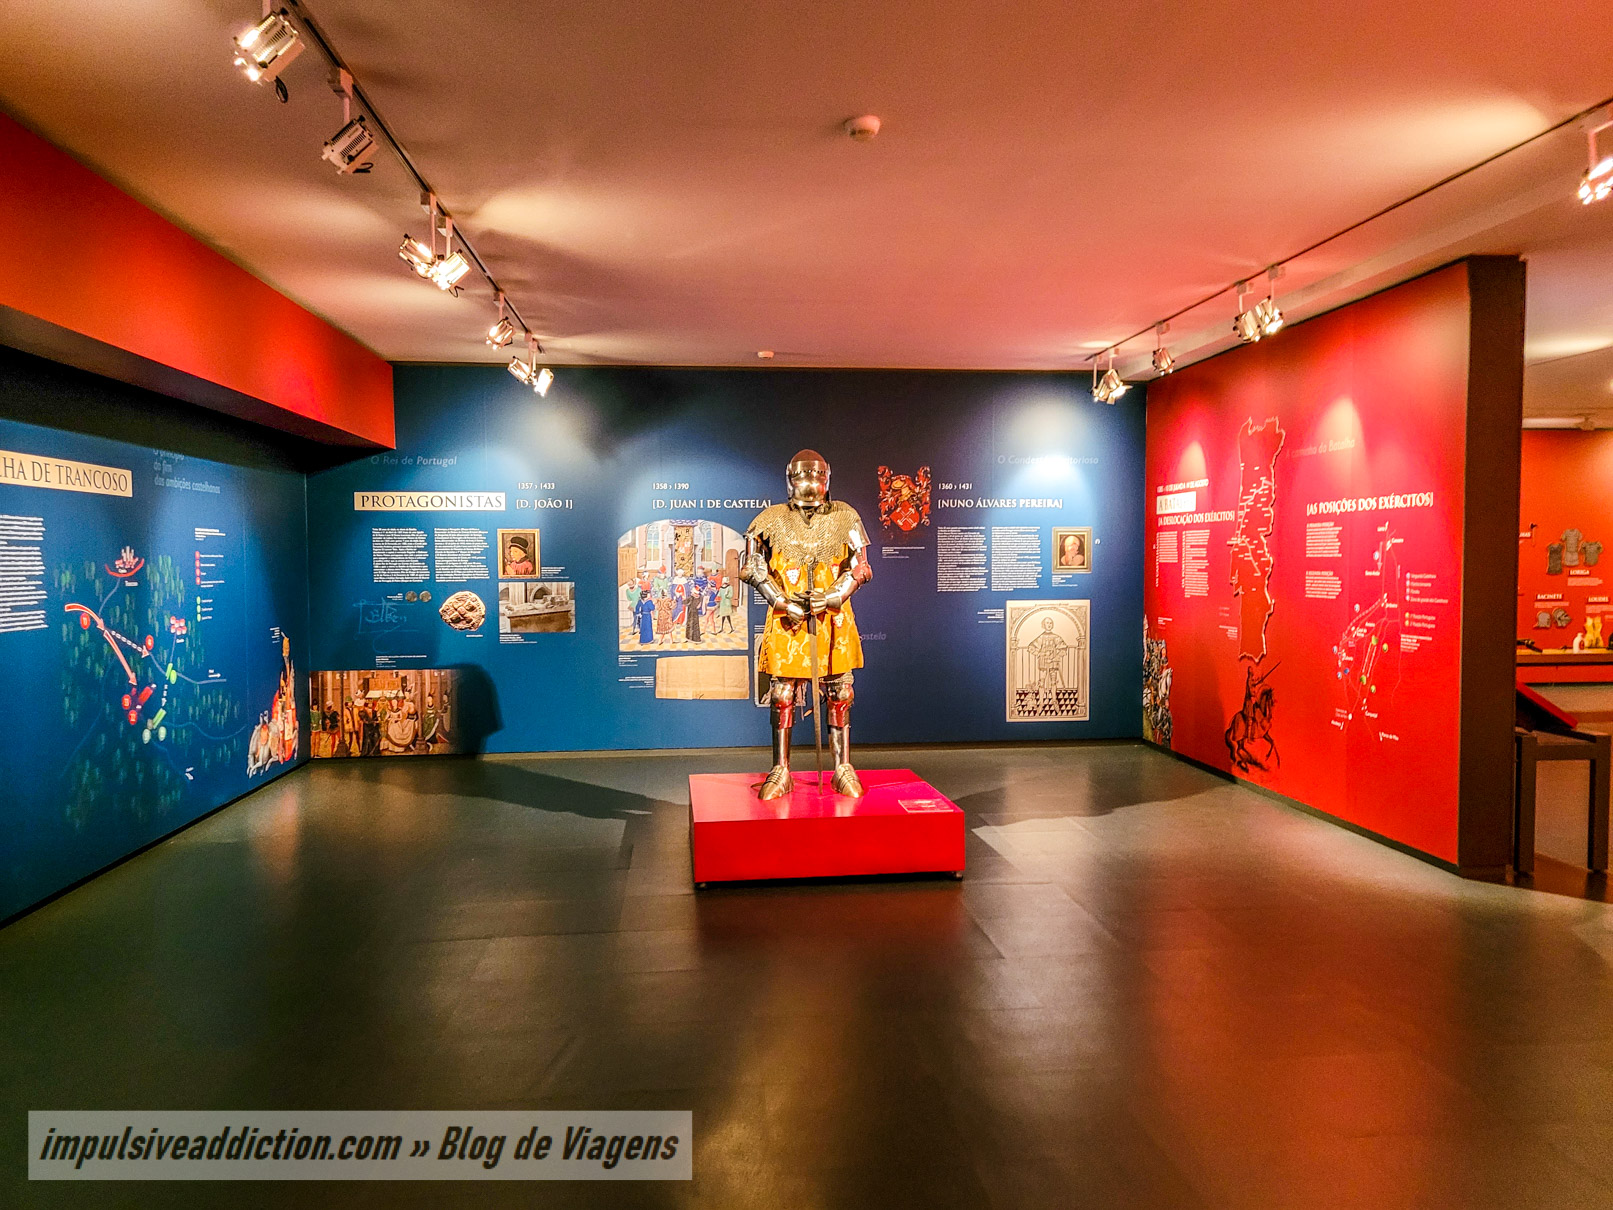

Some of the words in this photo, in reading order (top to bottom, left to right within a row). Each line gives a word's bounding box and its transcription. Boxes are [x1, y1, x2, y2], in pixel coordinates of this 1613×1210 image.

[370, 455, 380, 465] O
[383, 455, 399, 465] Rei
[401, 456, 413, 465] de
[416, 455, 458, 468] Portugal
[997, 455, 1006, 464] O
[0, 456, 27, 480] HA
[31, 461, 51, 483] DE
[55, 464, 128, 492] TRANCOSO
[517, 482, 533, 490] 1357
[540, 482, 555, 490] 1433
[360, 494, 502, 508] PROTAGONISTAS
[533, 497, 562, 510] JOÃO
[669, 500, 696, 510] JUAN
[700, 500, 704, 508] I
[707, 500, 721, 508] DE
[976, 497, 1017, 508] ÁLVARES
[1318, 498, 1357, 516] POSIÇÕES
[1358, 496, 1377, 512] DOS
[1193, 513, 1204, 523] DOS
[860, 632, 886, 640] astela
